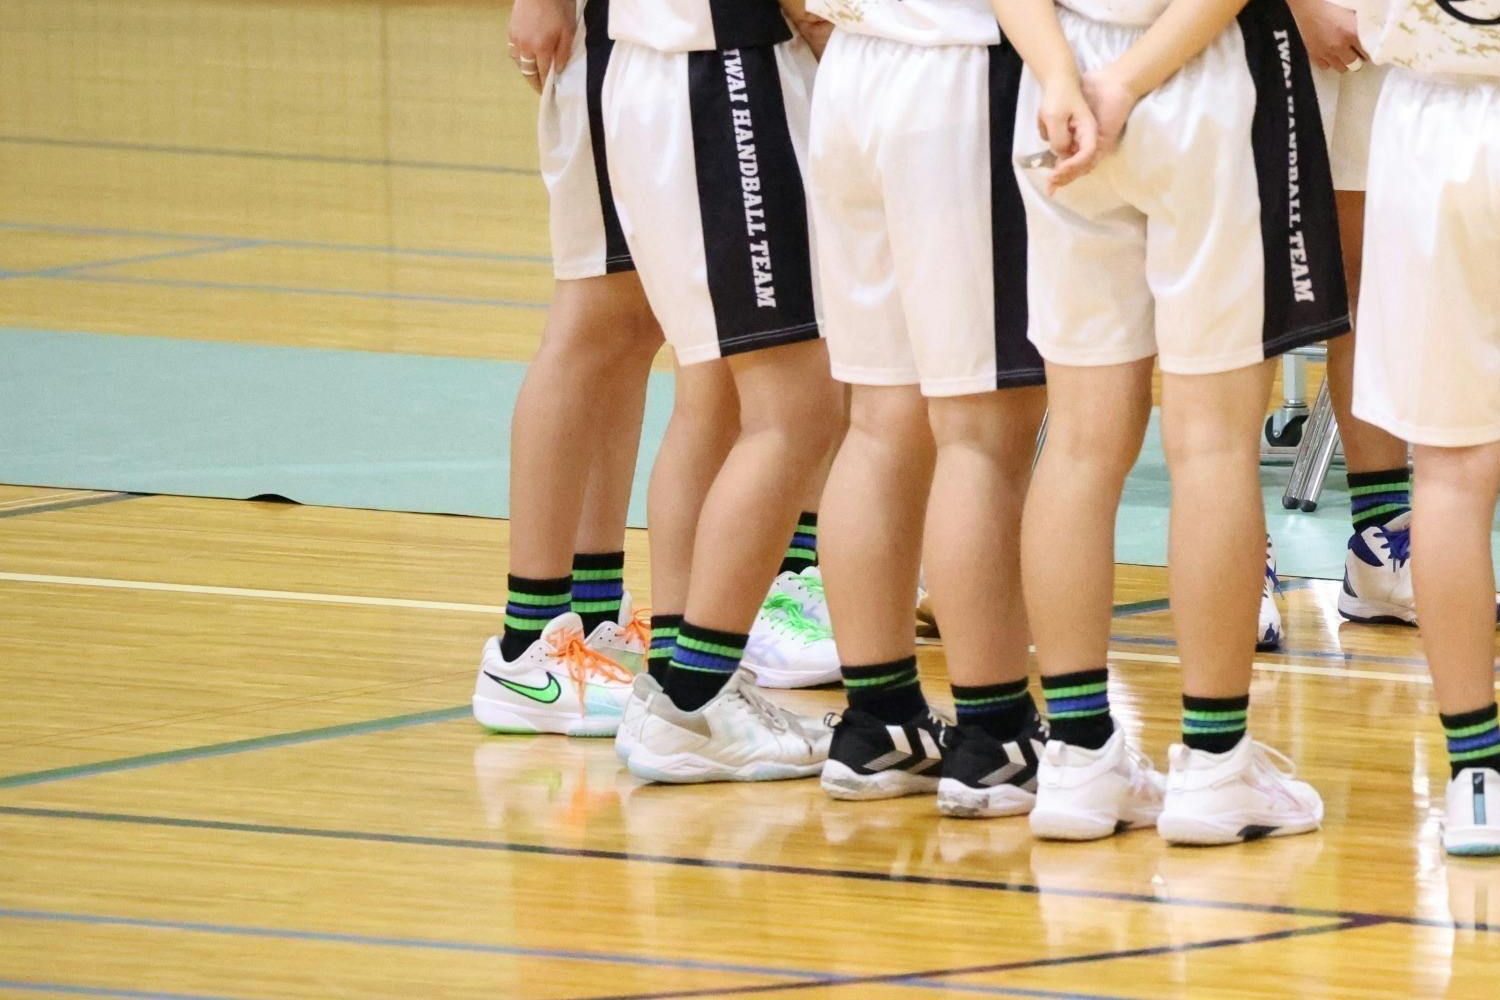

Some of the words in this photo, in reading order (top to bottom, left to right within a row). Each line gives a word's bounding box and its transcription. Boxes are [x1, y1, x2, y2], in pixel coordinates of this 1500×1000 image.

[723, 48, 749, 102] IWAI
[732, 108, 767, 237] HANDBALL
[750, 240, 777, 308] TEAM
[1289, 230, 1316, 302] TEAM
